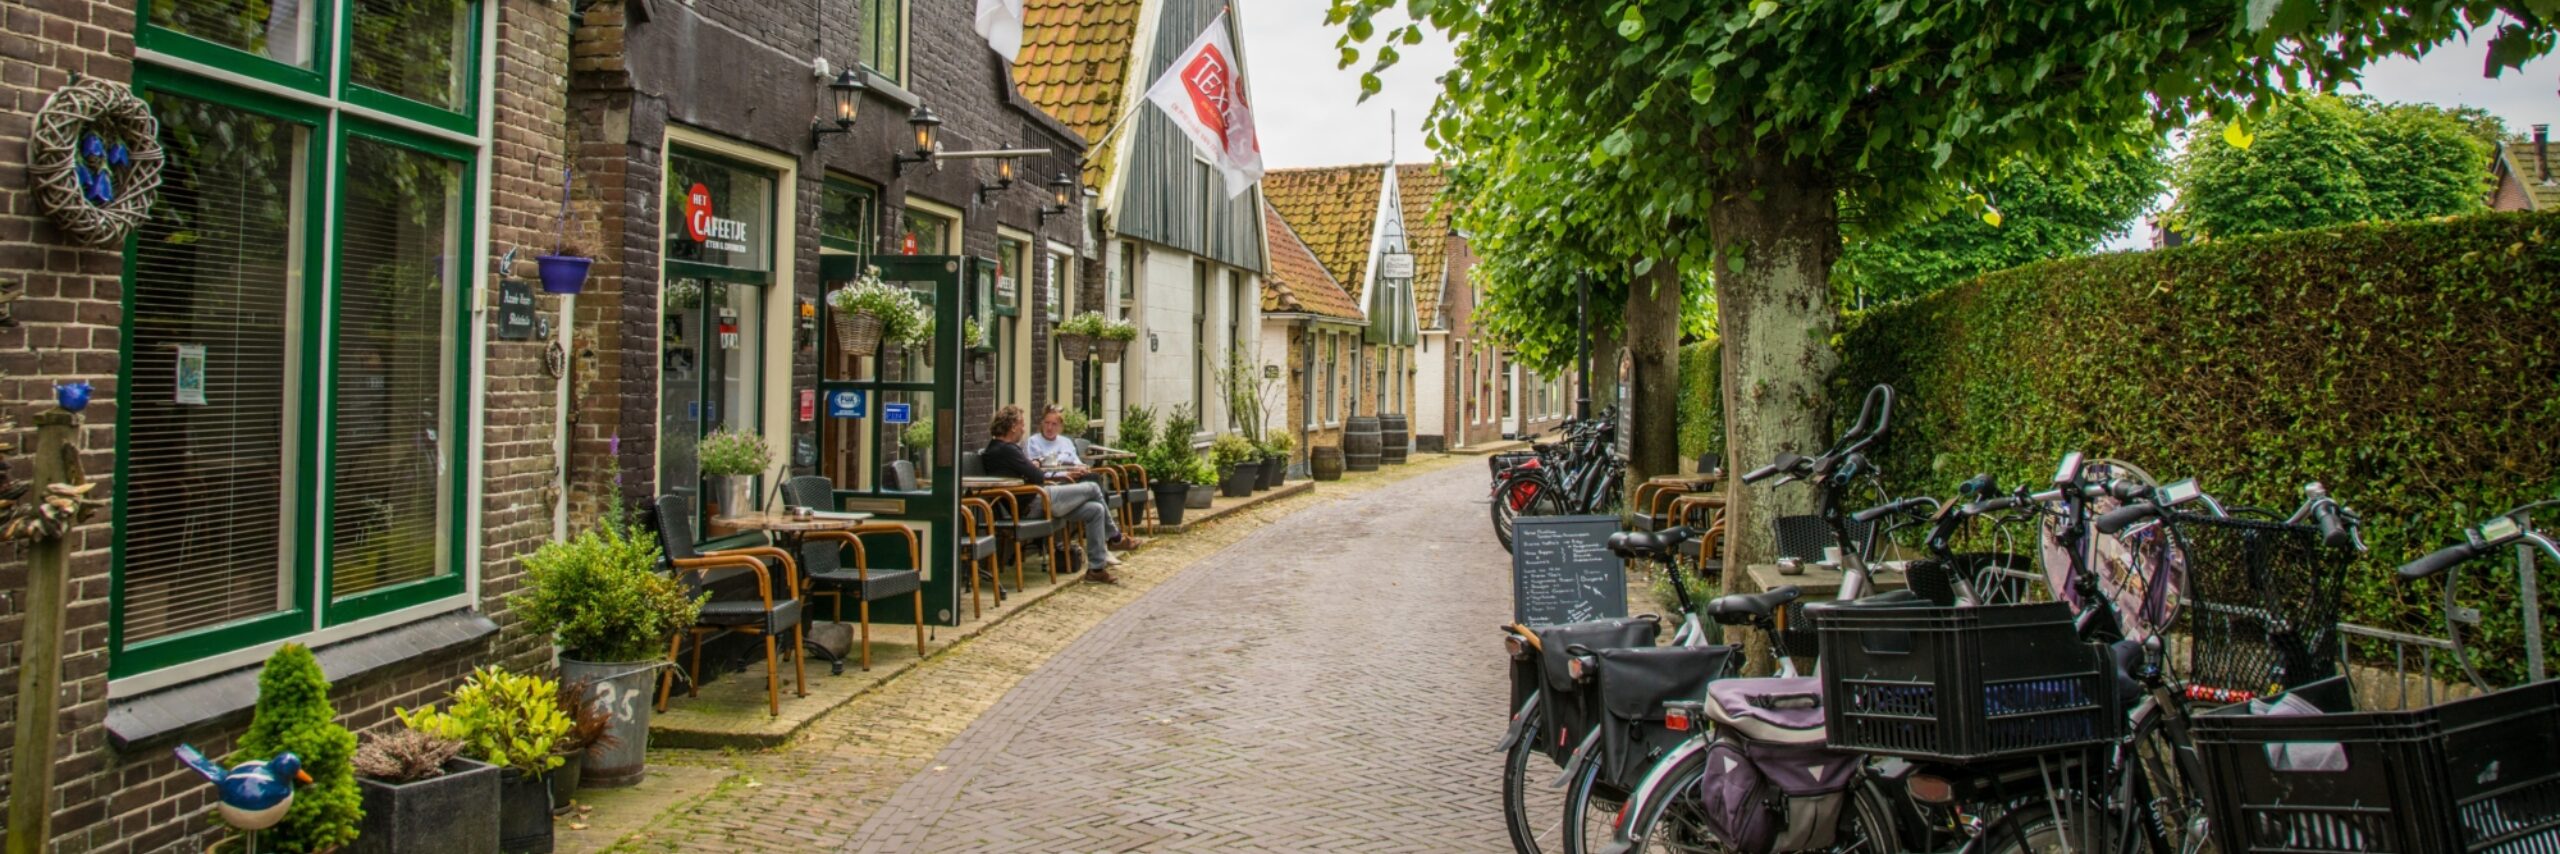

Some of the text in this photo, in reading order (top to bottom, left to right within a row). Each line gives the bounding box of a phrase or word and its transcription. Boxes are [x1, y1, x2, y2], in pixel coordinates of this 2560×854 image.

[693, 193, 707, 206] HET
[694, 210, 747, 242] CAFEETJE
[540, 318, 548, 337] 5
